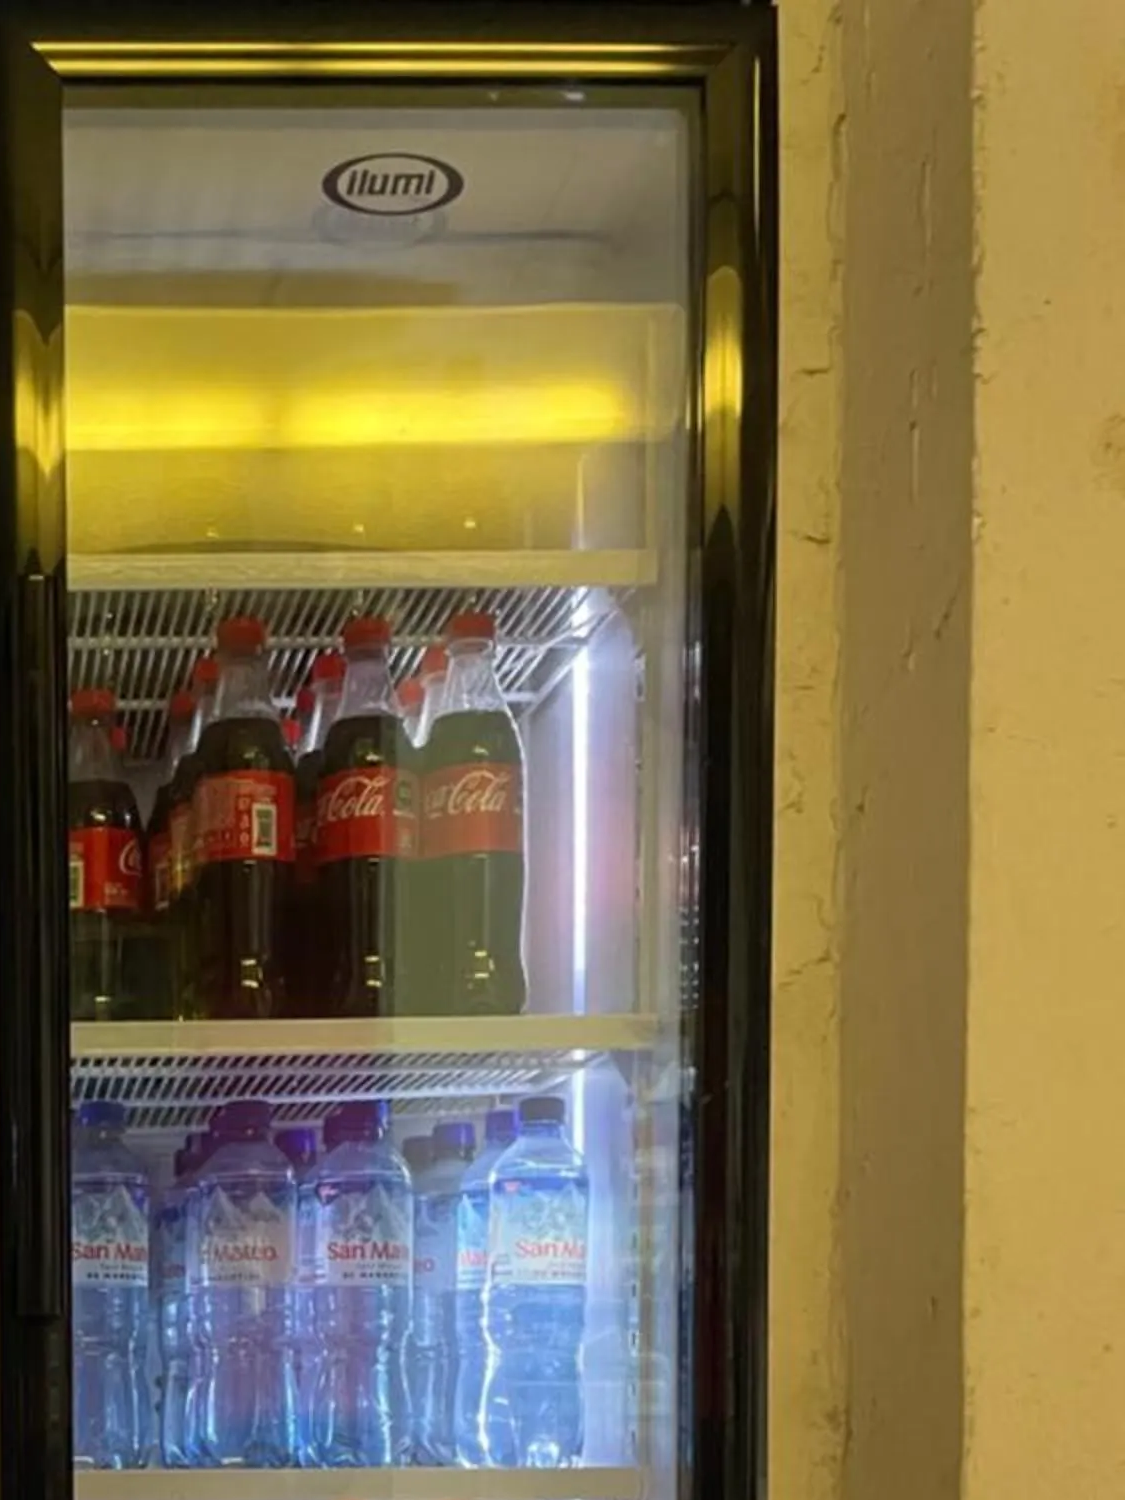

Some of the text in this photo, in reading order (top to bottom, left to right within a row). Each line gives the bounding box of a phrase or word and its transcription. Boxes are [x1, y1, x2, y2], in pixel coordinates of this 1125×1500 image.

[72, 1243, 109, 1261] San
[327, 1241, 366, 1260] San
[516, 1240, 558, 1258] San
